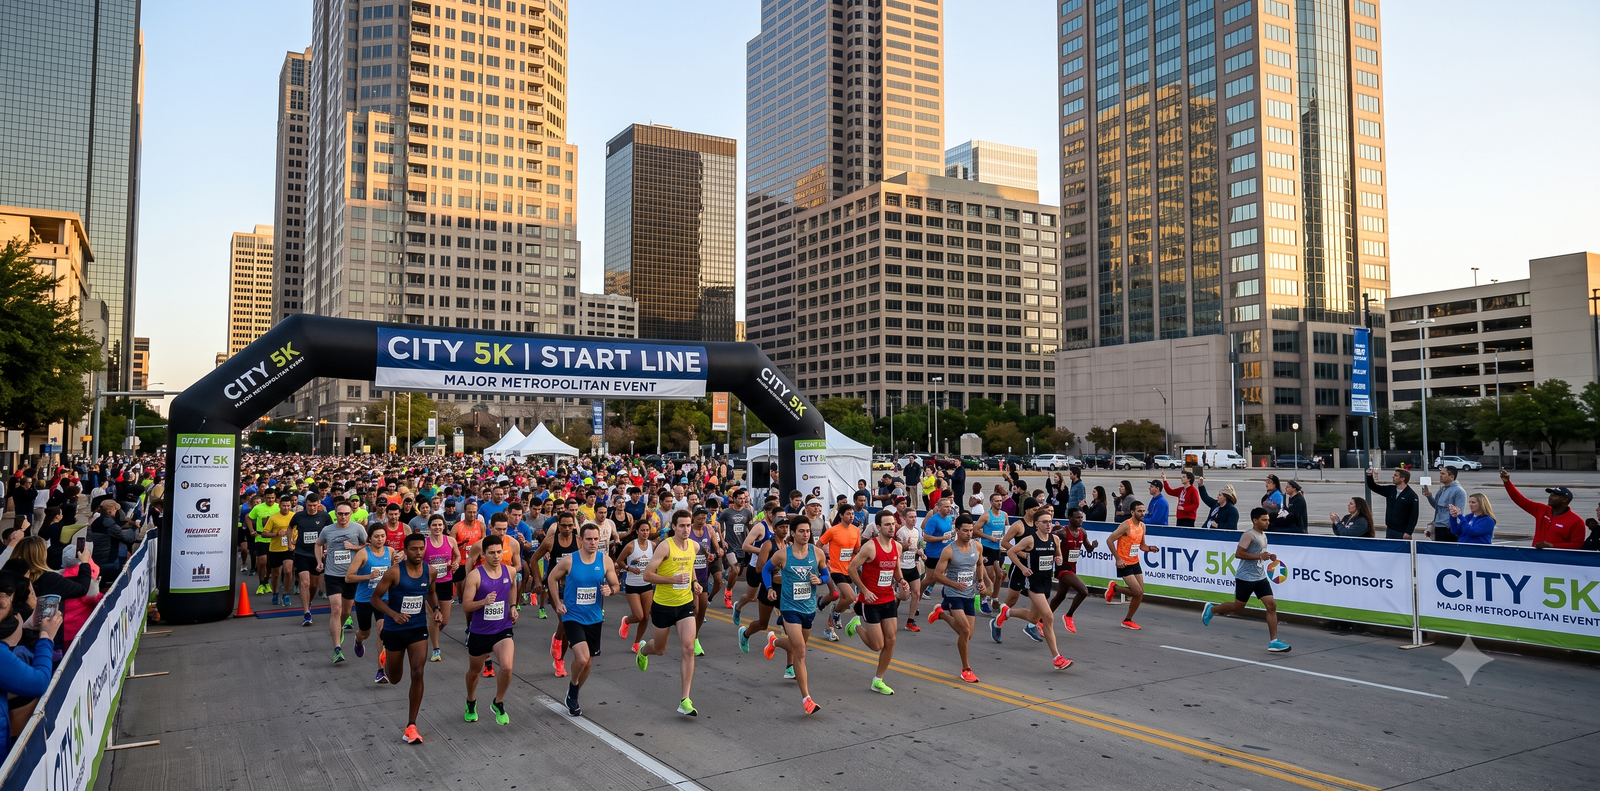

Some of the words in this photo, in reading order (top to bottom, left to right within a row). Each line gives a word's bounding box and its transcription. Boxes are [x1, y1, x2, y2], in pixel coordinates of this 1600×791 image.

[388, 337, 464, 363] CITY
[474, 342, 514, 366] 5K
[541, 346, 631, 371] START
[641, 350, 701, 373] LINE
[224, 361, 269, 400] CITY
[270, 341, 301, 368] 5K
[444, 375, 497, 388] MAJOR
[502, 377, 610, 391] METROPOLITAN
[614, 381, 657, 392] EVENT
[760, 367, 791, 398] CITY
[789, 395, 808, 418] 5K
[181, 455, 210, 465] CITY
[213, 455, 229, 465] 5K
[799, 455, 819, 463] CITY
[1143, 546, 1199, 572] CITY
[1205, 550, 1236, 577] 5K
[1144, 571, 1166, 579] MAJOR
[1166, 573, 1216, 586] METROPOLITAN
[1292, 568, 1321, 582] PBC
[1324, 570, 1394, 589] Sponsors
[1436, 568, 1532, 605] CITY
[1542, 576, 1600, 613] 5K
[1437, 601, 1473, 613] MAJOR
[1475, 606, 1559, 623] METROPOLITAN
[1562, 614, 1600, 627] EVENT
[73, 695, 84, 767] 5K
